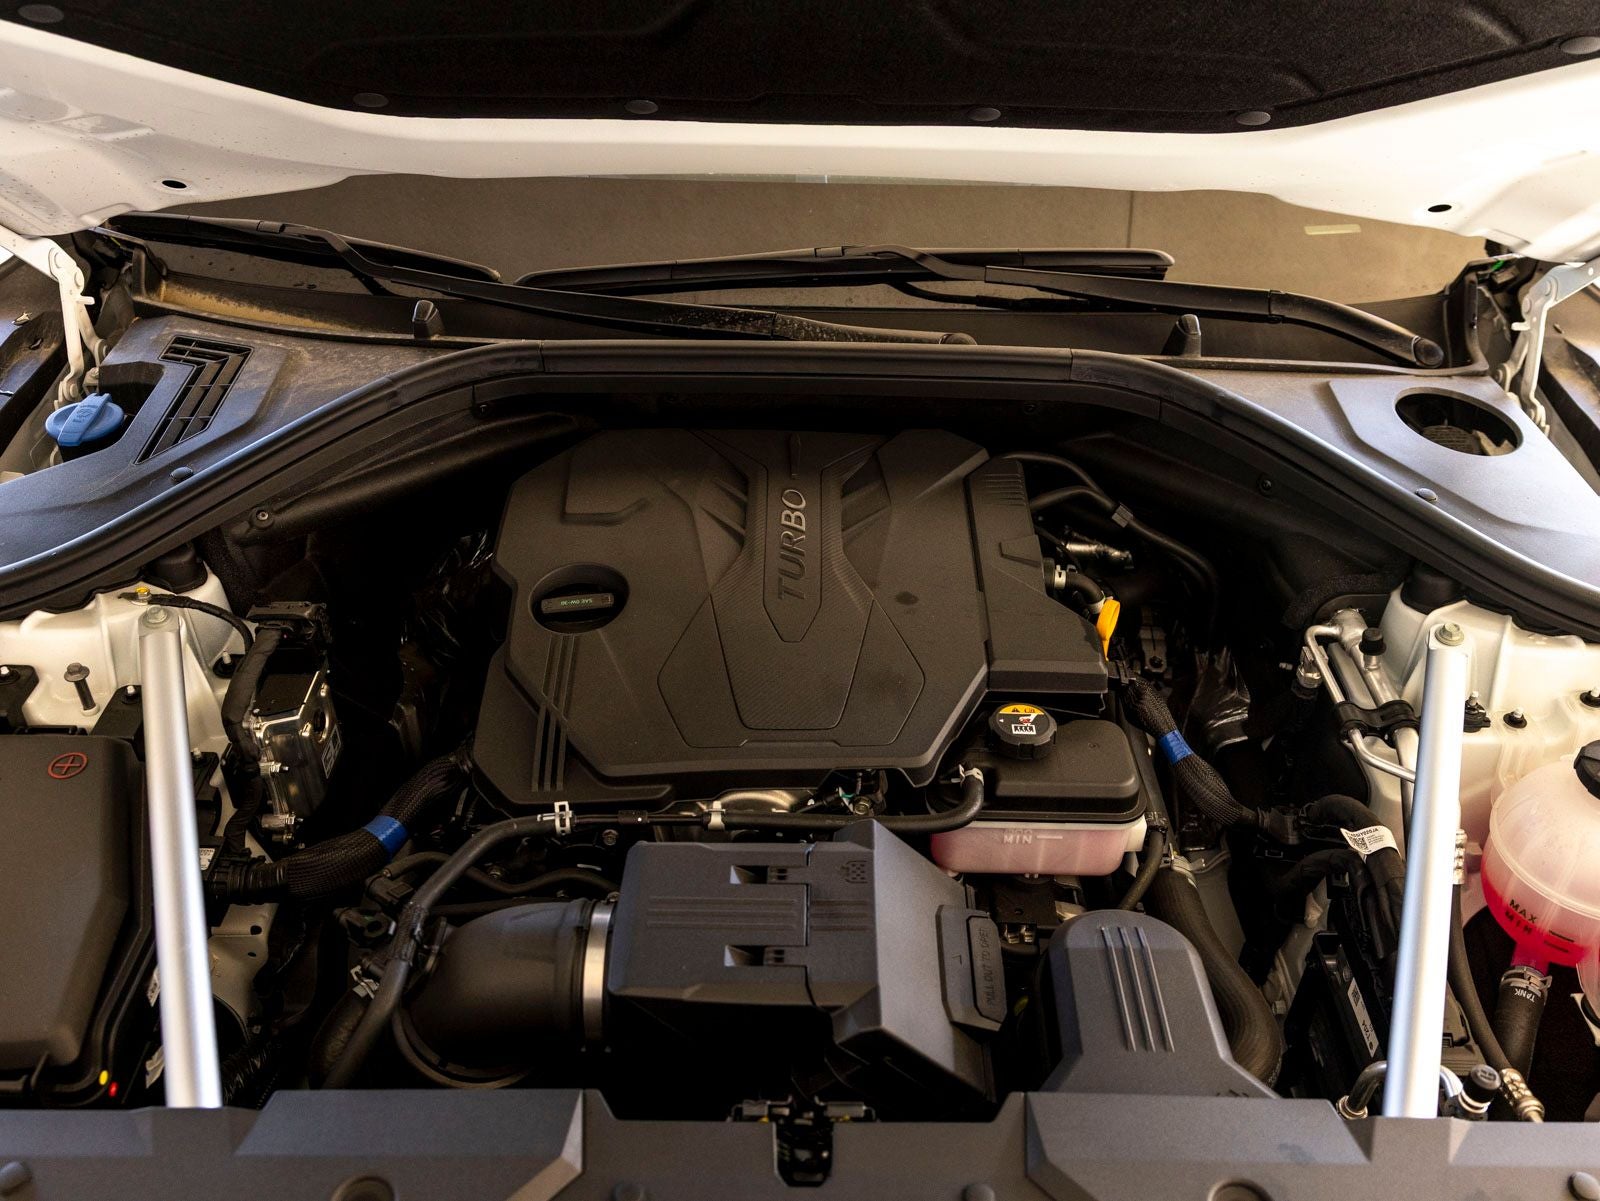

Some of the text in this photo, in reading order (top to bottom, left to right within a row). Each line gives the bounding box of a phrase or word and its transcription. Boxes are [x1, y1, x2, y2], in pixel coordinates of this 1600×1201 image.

[778, 489, 807, 600] TURBO
[1003, 834, 1033, 845] MIN
[1509, 899, 1538, 924] MAX
[1505, 910, 1532, 935] MIN
[982, 965, 994, 982] OUT
[1514, 988, 1536, 1003] TANK
